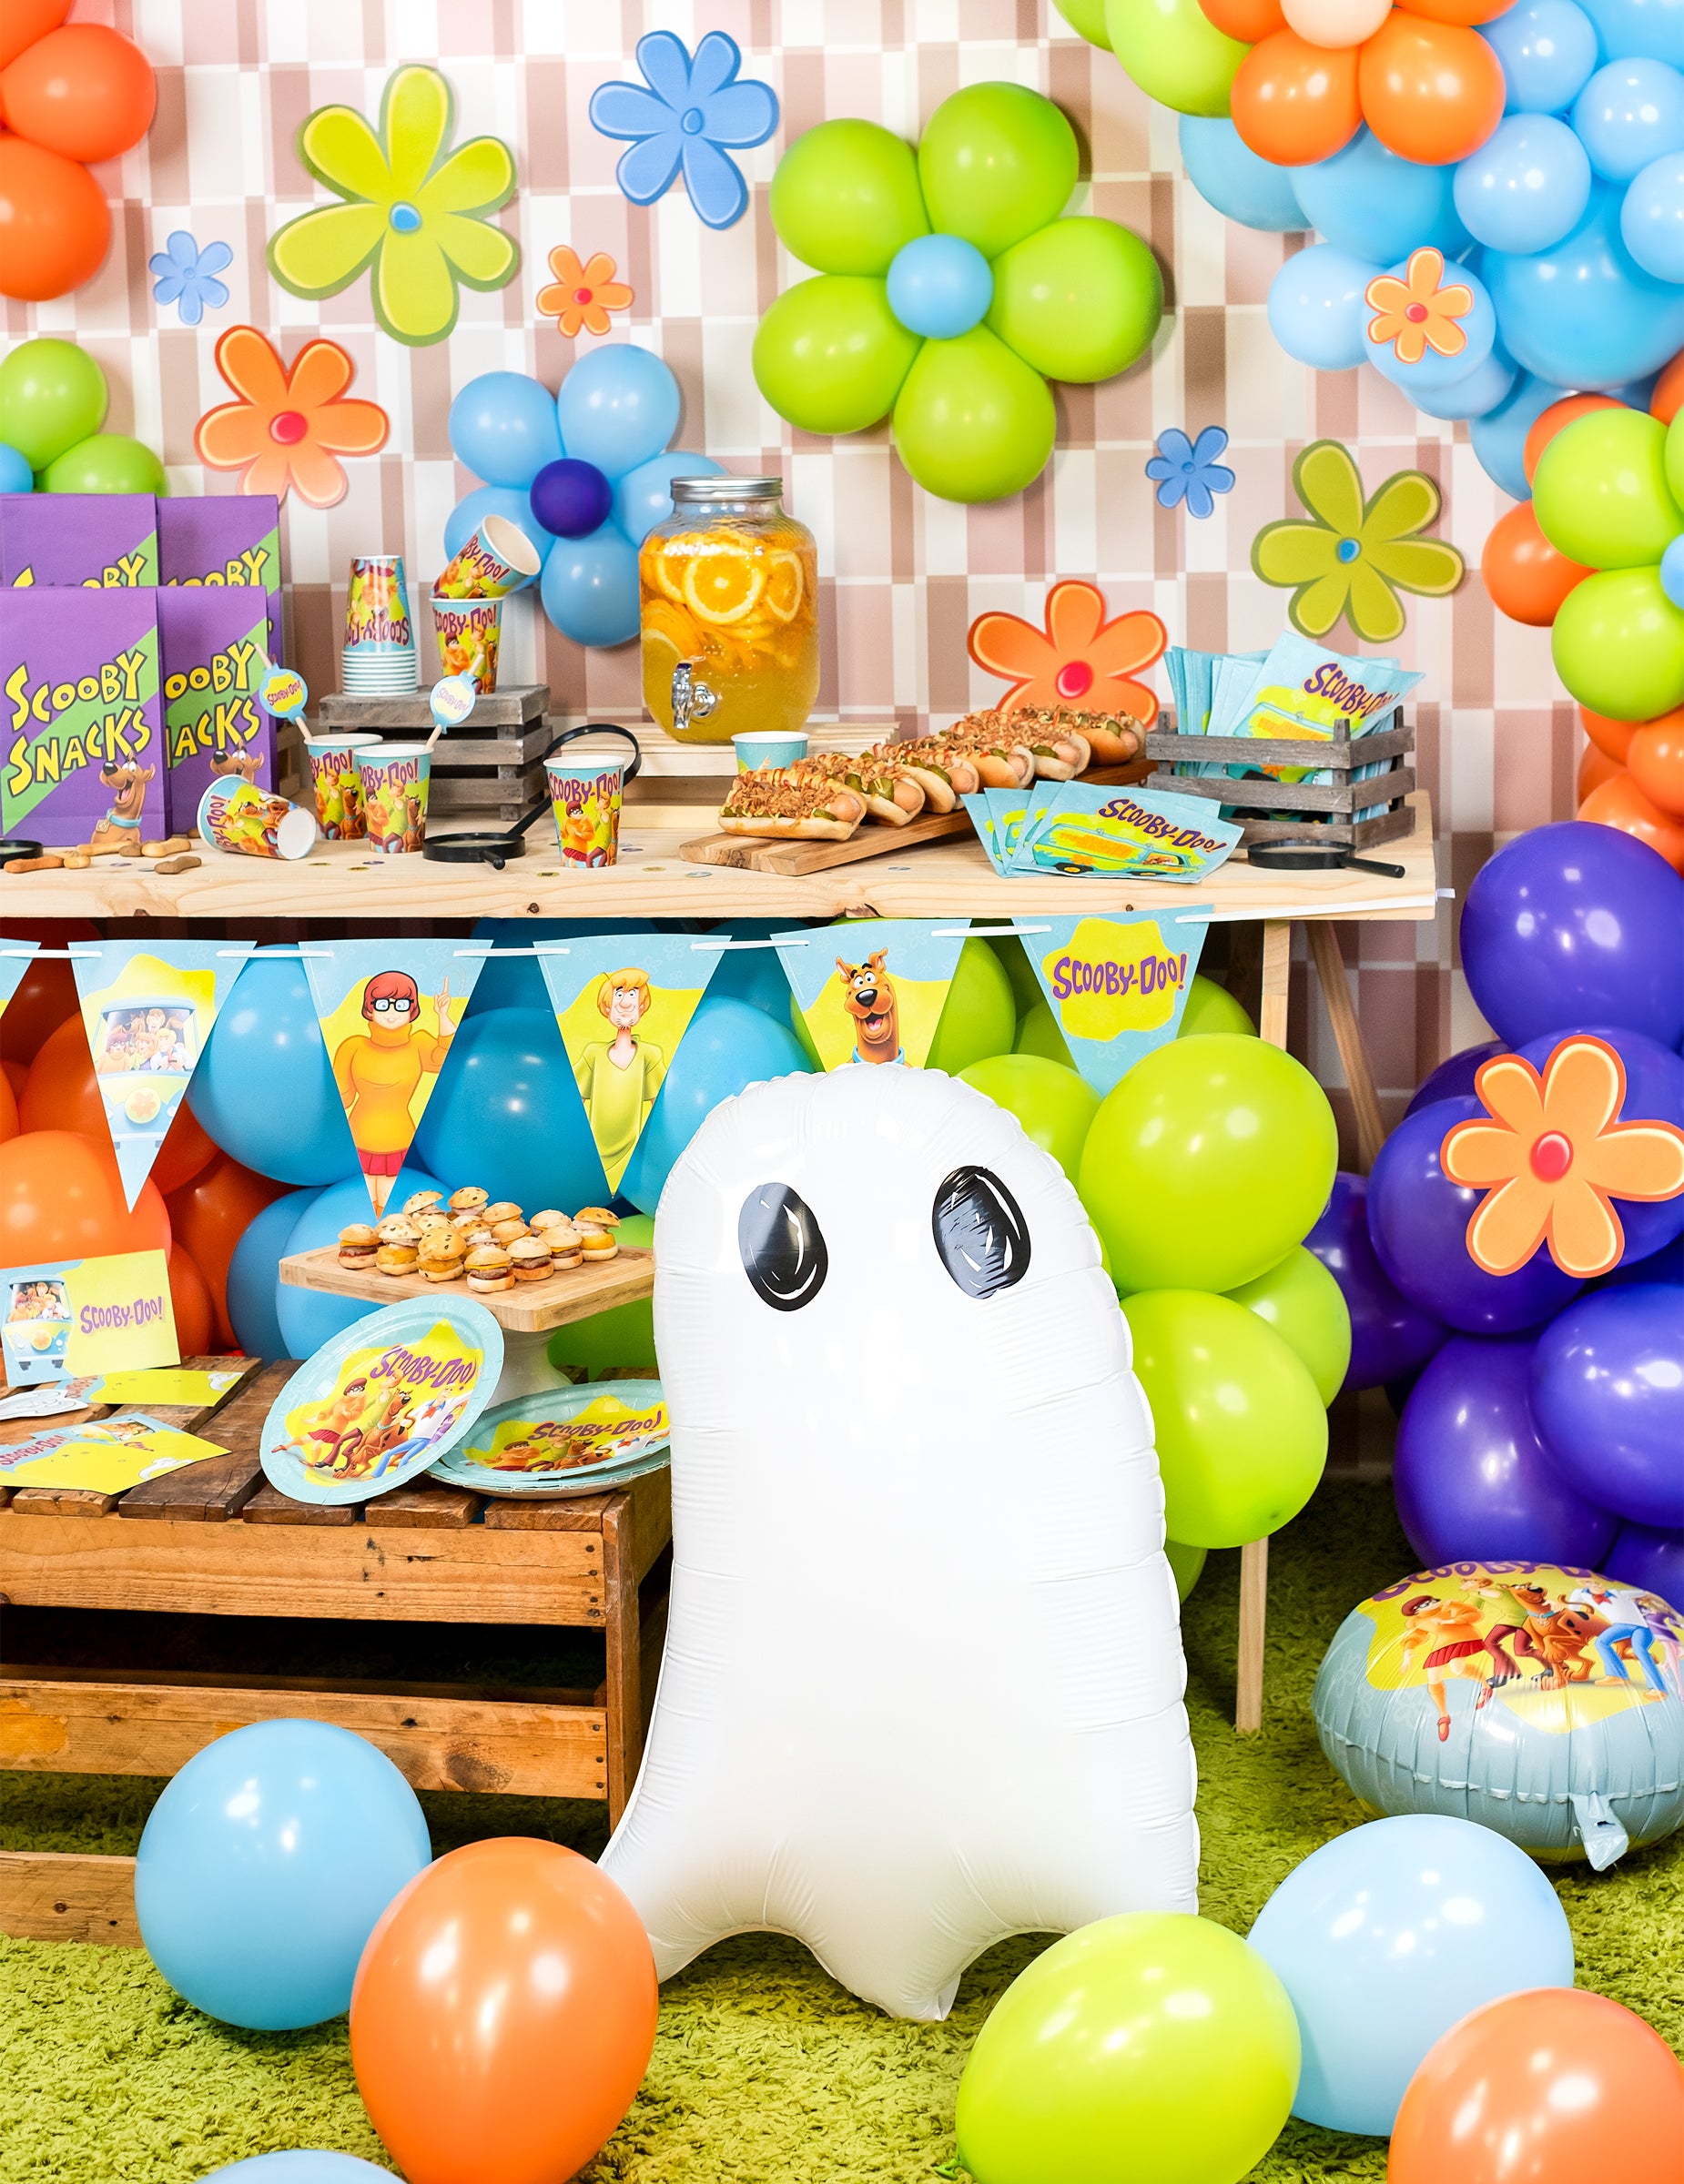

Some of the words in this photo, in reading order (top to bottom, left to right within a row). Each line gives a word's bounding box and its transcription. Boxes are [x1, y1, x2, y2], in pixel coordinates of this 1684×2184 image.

[5, 649, 148, 733] SCOOBY
[7, 705, 152, 798] SNACKS
[1098, 798, 1228, 854] SCOOBY-DOO!
[1051, 952, 1188, 1000] SCOOBY-DOO!
[79, 1295, 163, 1335] SCOOBY-DOO!
[369, 1345, 478, 1391] SCOOBY-DOO!
[526, 1410, 663, 1441] SCOOBY-DOO!
